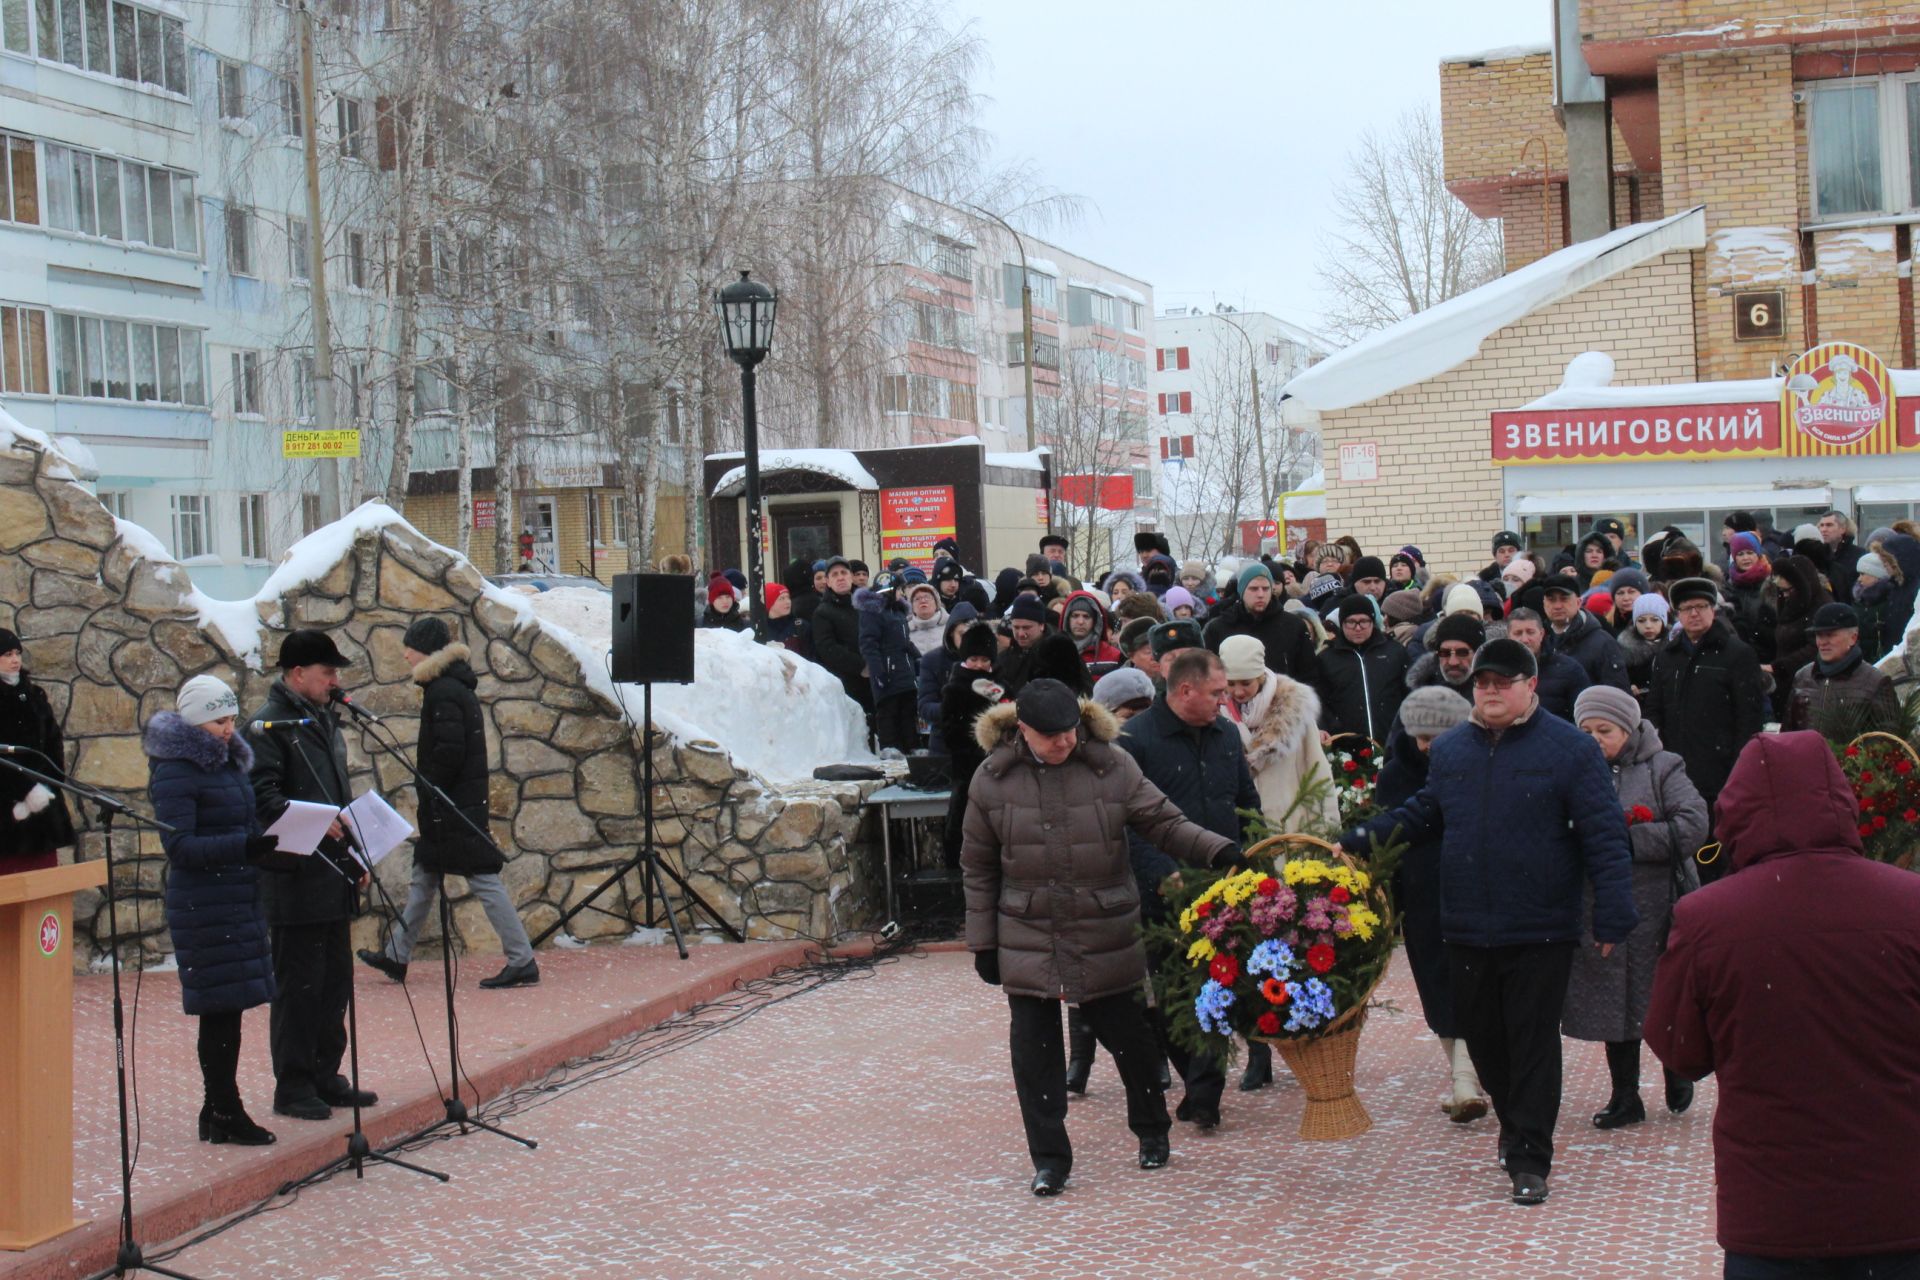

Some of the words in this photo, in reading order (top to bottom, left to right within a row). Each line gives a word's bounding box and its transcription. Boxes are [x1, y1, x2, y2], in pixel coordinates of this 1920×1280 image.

[1751, 303, 1769, 327] 6
[1800, 407, 1881, 424] Звенигов
[1505, 408, 1764, 449] ЗВЕНИГОВСКИЙ
[286, 432, 320, 442] ДЕНЬГИ
[340, 431, 357, 440] ПТС
[292, 442, 305, 450] 917
[322, 441, 332, 449] 00
[333, 441, 343, 449] 02
[890, 541, 920, 549] РЕМОНТ
